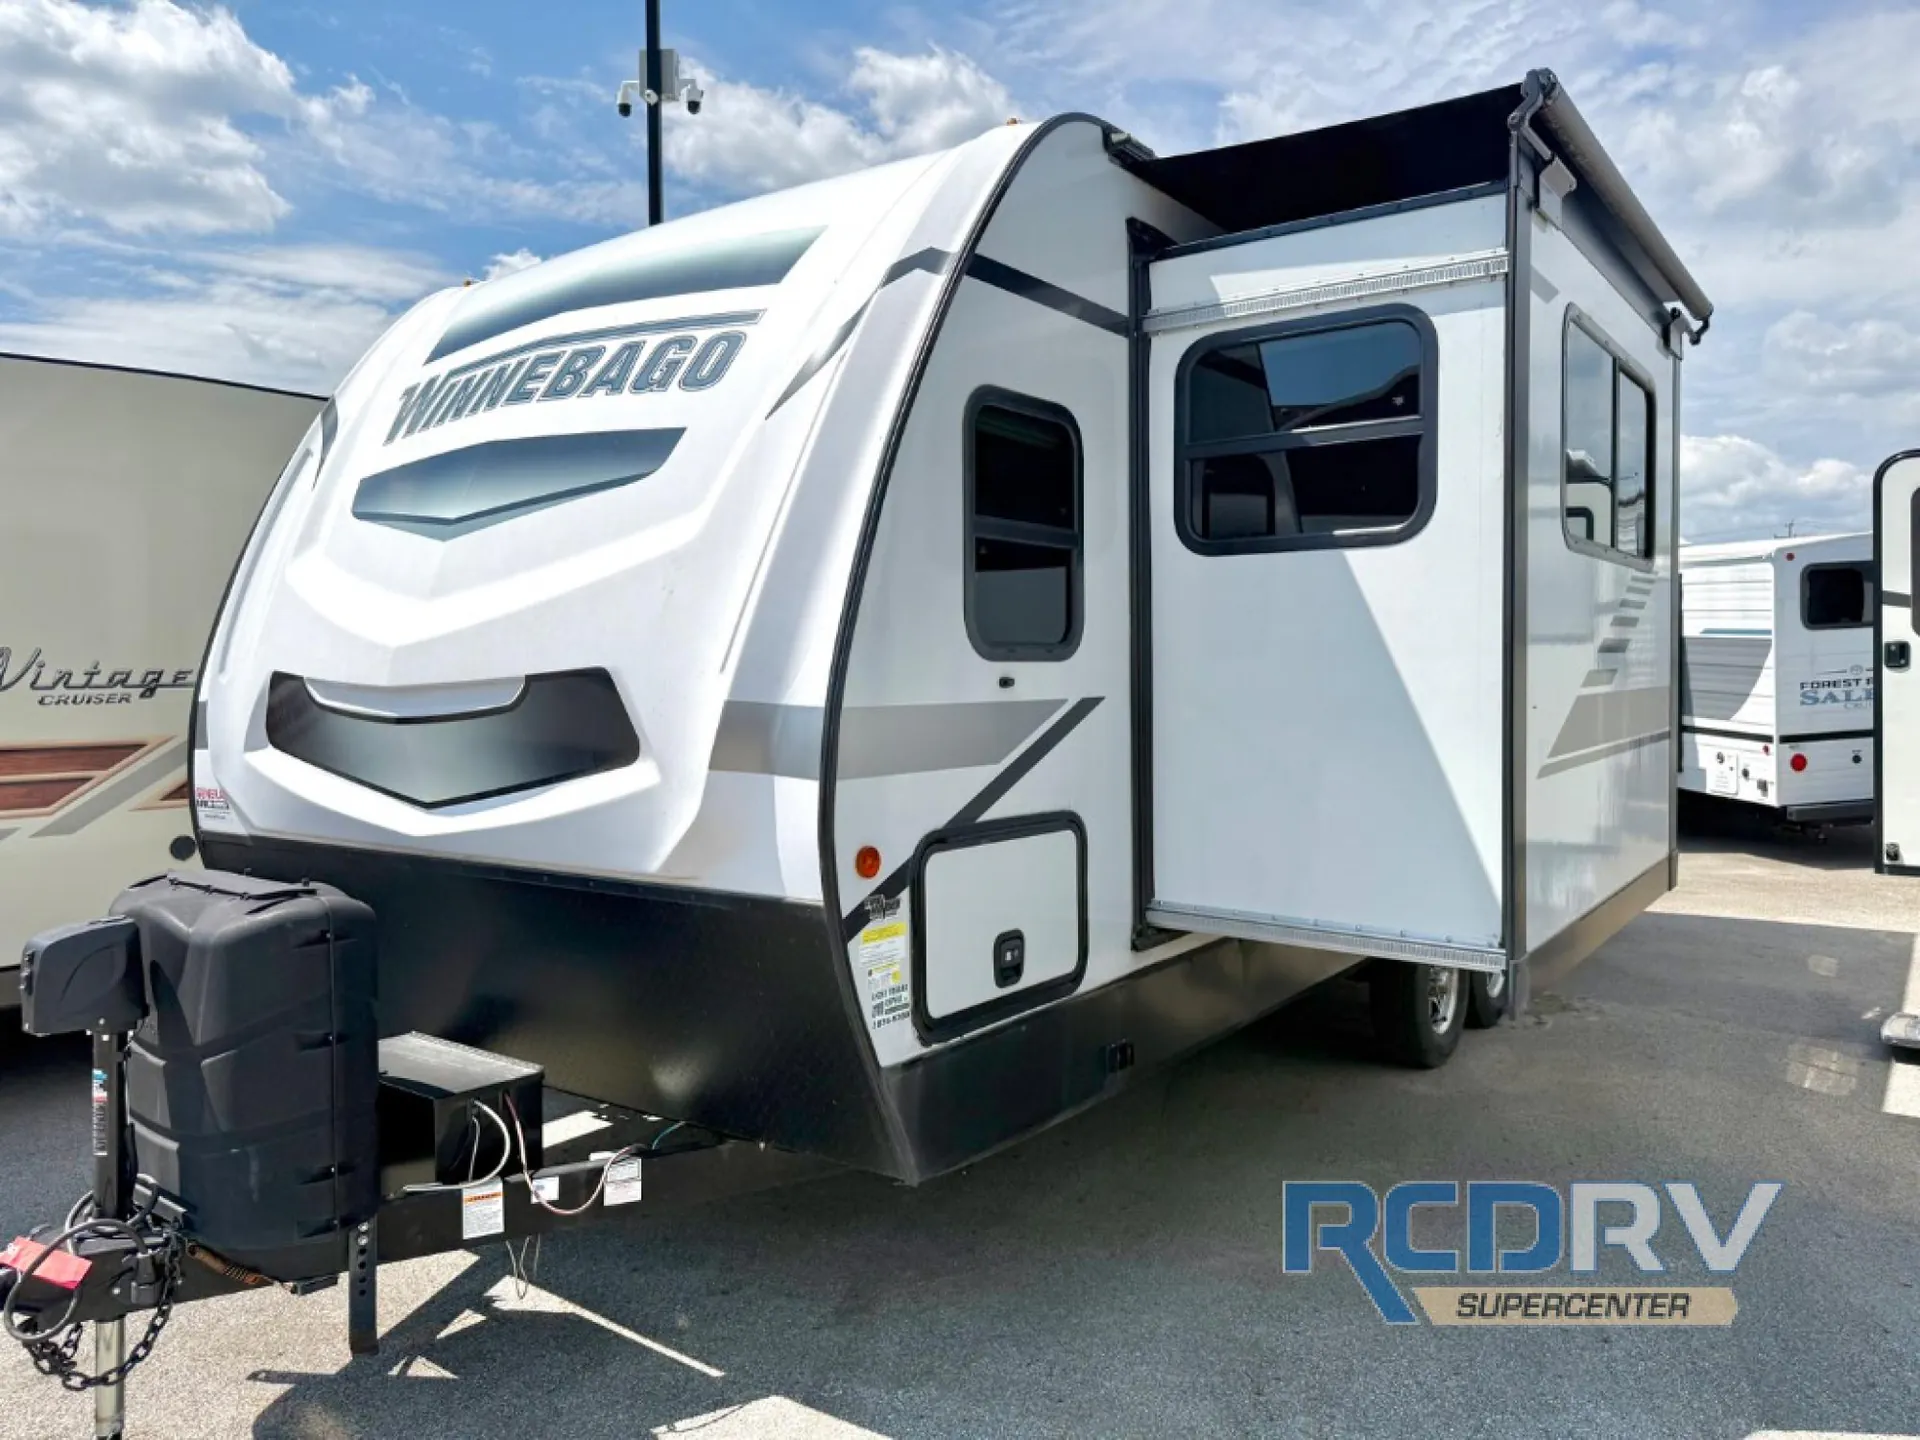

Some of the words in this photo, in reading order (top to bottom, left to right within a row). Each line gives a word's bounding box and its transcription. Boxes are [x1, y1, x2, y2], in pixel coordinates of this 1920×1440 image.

[382, 329, 748, 447] WINNEBAGO
[0, 646, 196, 699] Vintage
[1800, 678, 1862, 690] FOREST
[37, 692, 132, 706] CRUISER
